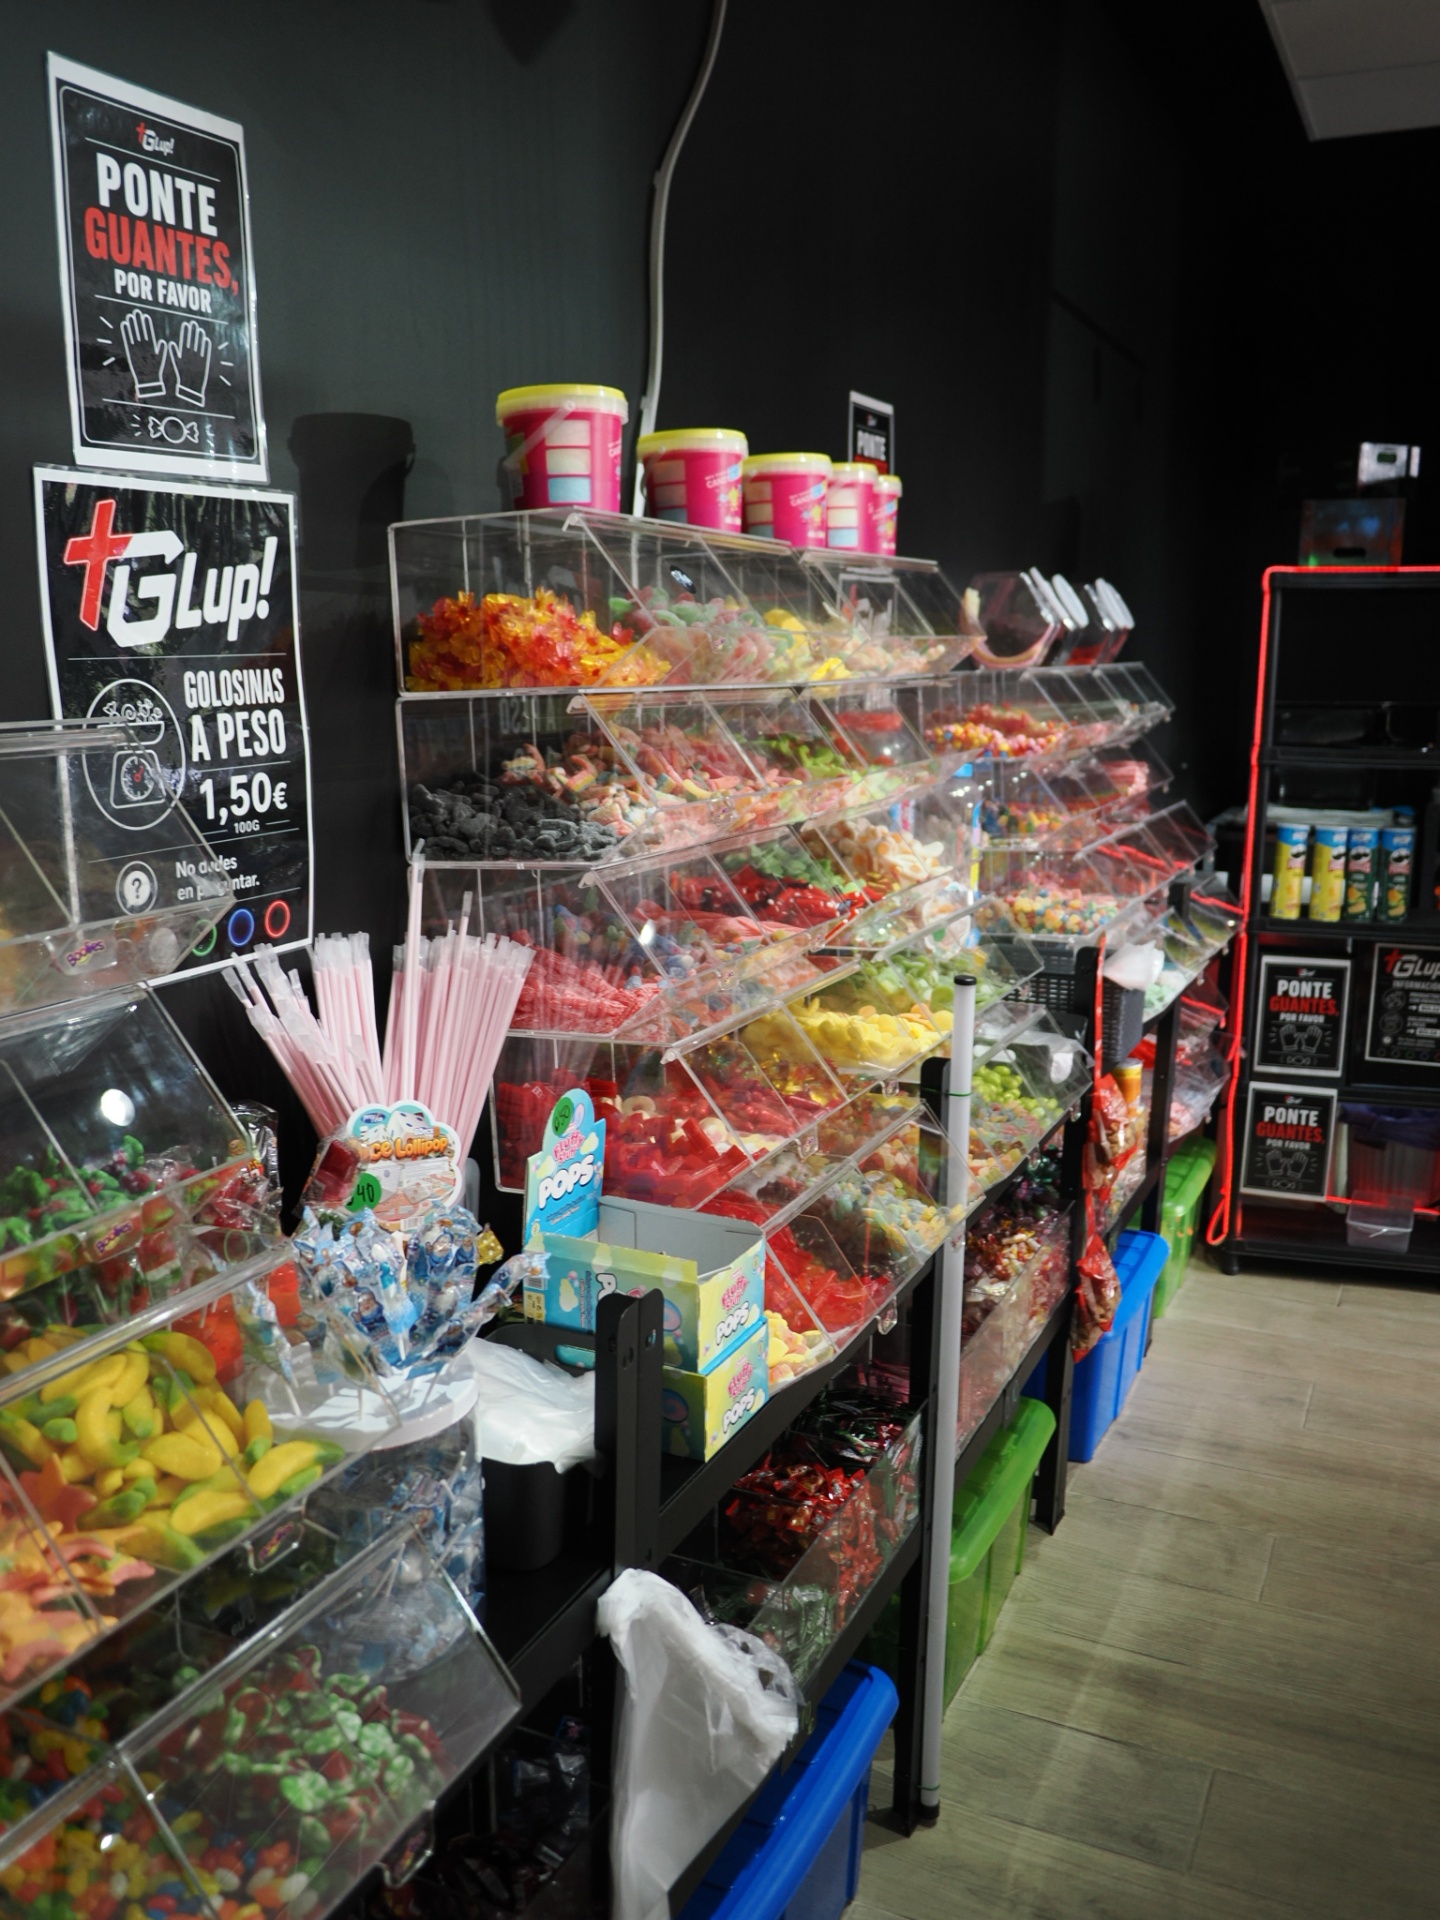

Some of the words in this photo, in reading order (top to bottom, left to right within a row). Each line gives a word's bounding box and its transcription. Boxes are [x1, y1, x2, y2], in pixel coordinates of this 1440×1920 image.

[95, 152, 218, 236] PONTE
[83, 206, 239, 296] GUANTES,
[114, 268, 153, 303] POR
[157, 277, 212, 313] FAVOR
[183, 668, 285, 709] GOLOSINAS
[191, 713, 210, 762] A
[219, 708, 287, 760] PESO
[199, 771, 288, 826] 1,50€
[233, 819, 260, 834] 100G
[175, 860, 196, 878] No
[177, 886, 194, 900] en
[1277, 979, 1333, 999] PONTE
[1269, 995, 1339, 1016] GUANTES,
[1279, 1012, 1297, 1021] POR
[1298, 1013, 1325, 1023] FAVOR
[1263, 1106, 1319, 1127] PONTE
[1255, 1120, 1325, 1145] GUANTES,
[1265, 1138, 1283, 1147] POR
[1284, 1140, 1311, 1150] FAVOR
[394, 1137, 449, 1161] Lollipop
[538, 1154, 595, 1209] POPS
[716, 1300, 749, 1346] POPS
[722, 1386, 755, 1434] POPS
